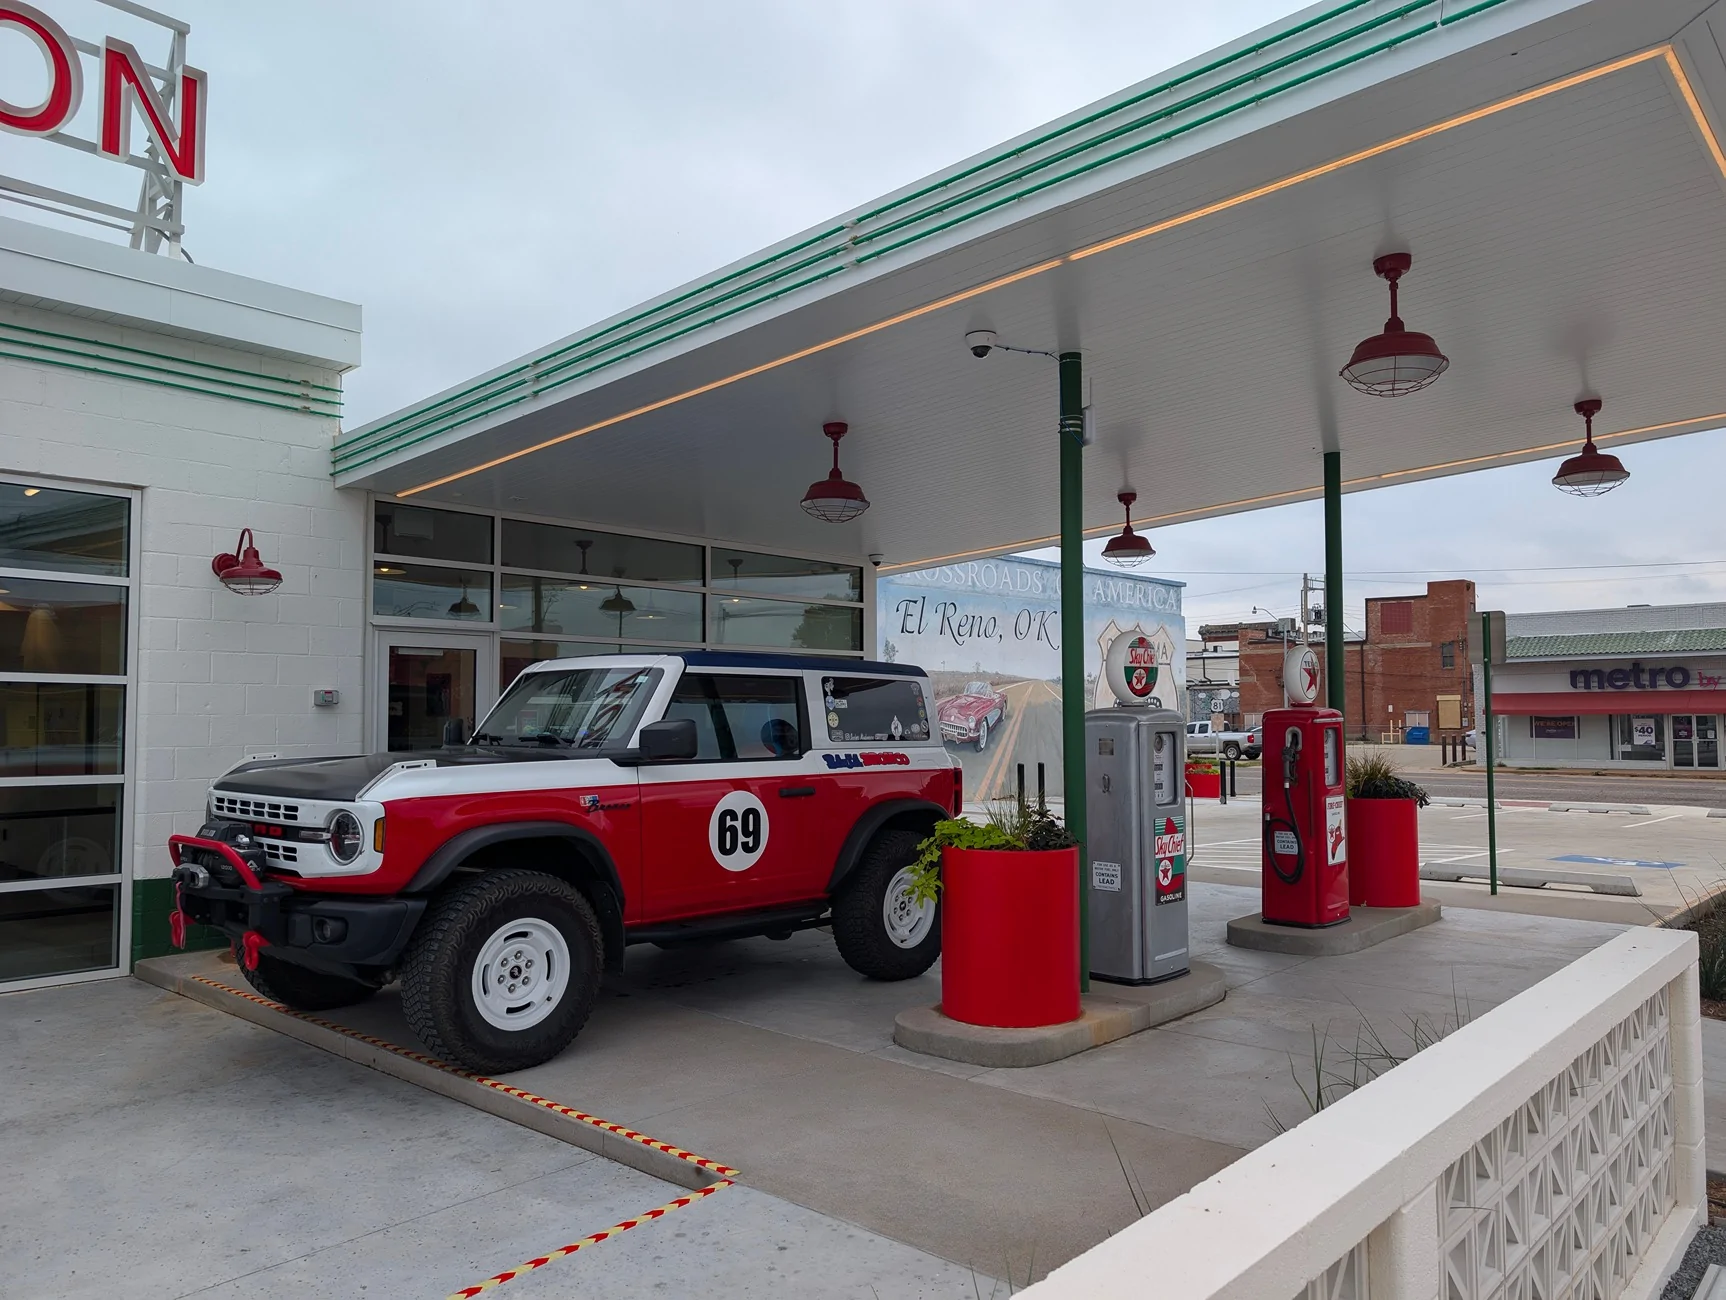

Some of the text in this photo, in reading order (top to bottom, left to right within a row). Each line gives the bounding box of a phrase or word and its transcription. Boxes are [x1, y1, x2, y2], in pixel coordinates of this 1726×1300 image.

[1092, 579, 1177, 610] AMERICA
[895, 595, 929, 635] El
[934, 601, 1004, 647] Reno,
[1014, 607, 1061, 651] OK
[1569, 662, 1722, 691] metro by
[1213, 701, 1222, 710] 81
[1634, 726, 1654, 735] $40
[718, 807, 761, 856] 69
[1155, 833, 1185, 858] Sky Chief
[1095, 871, 1119, 879] CONTAINS
[1160, 892, 1183, 904] GASOLINE
